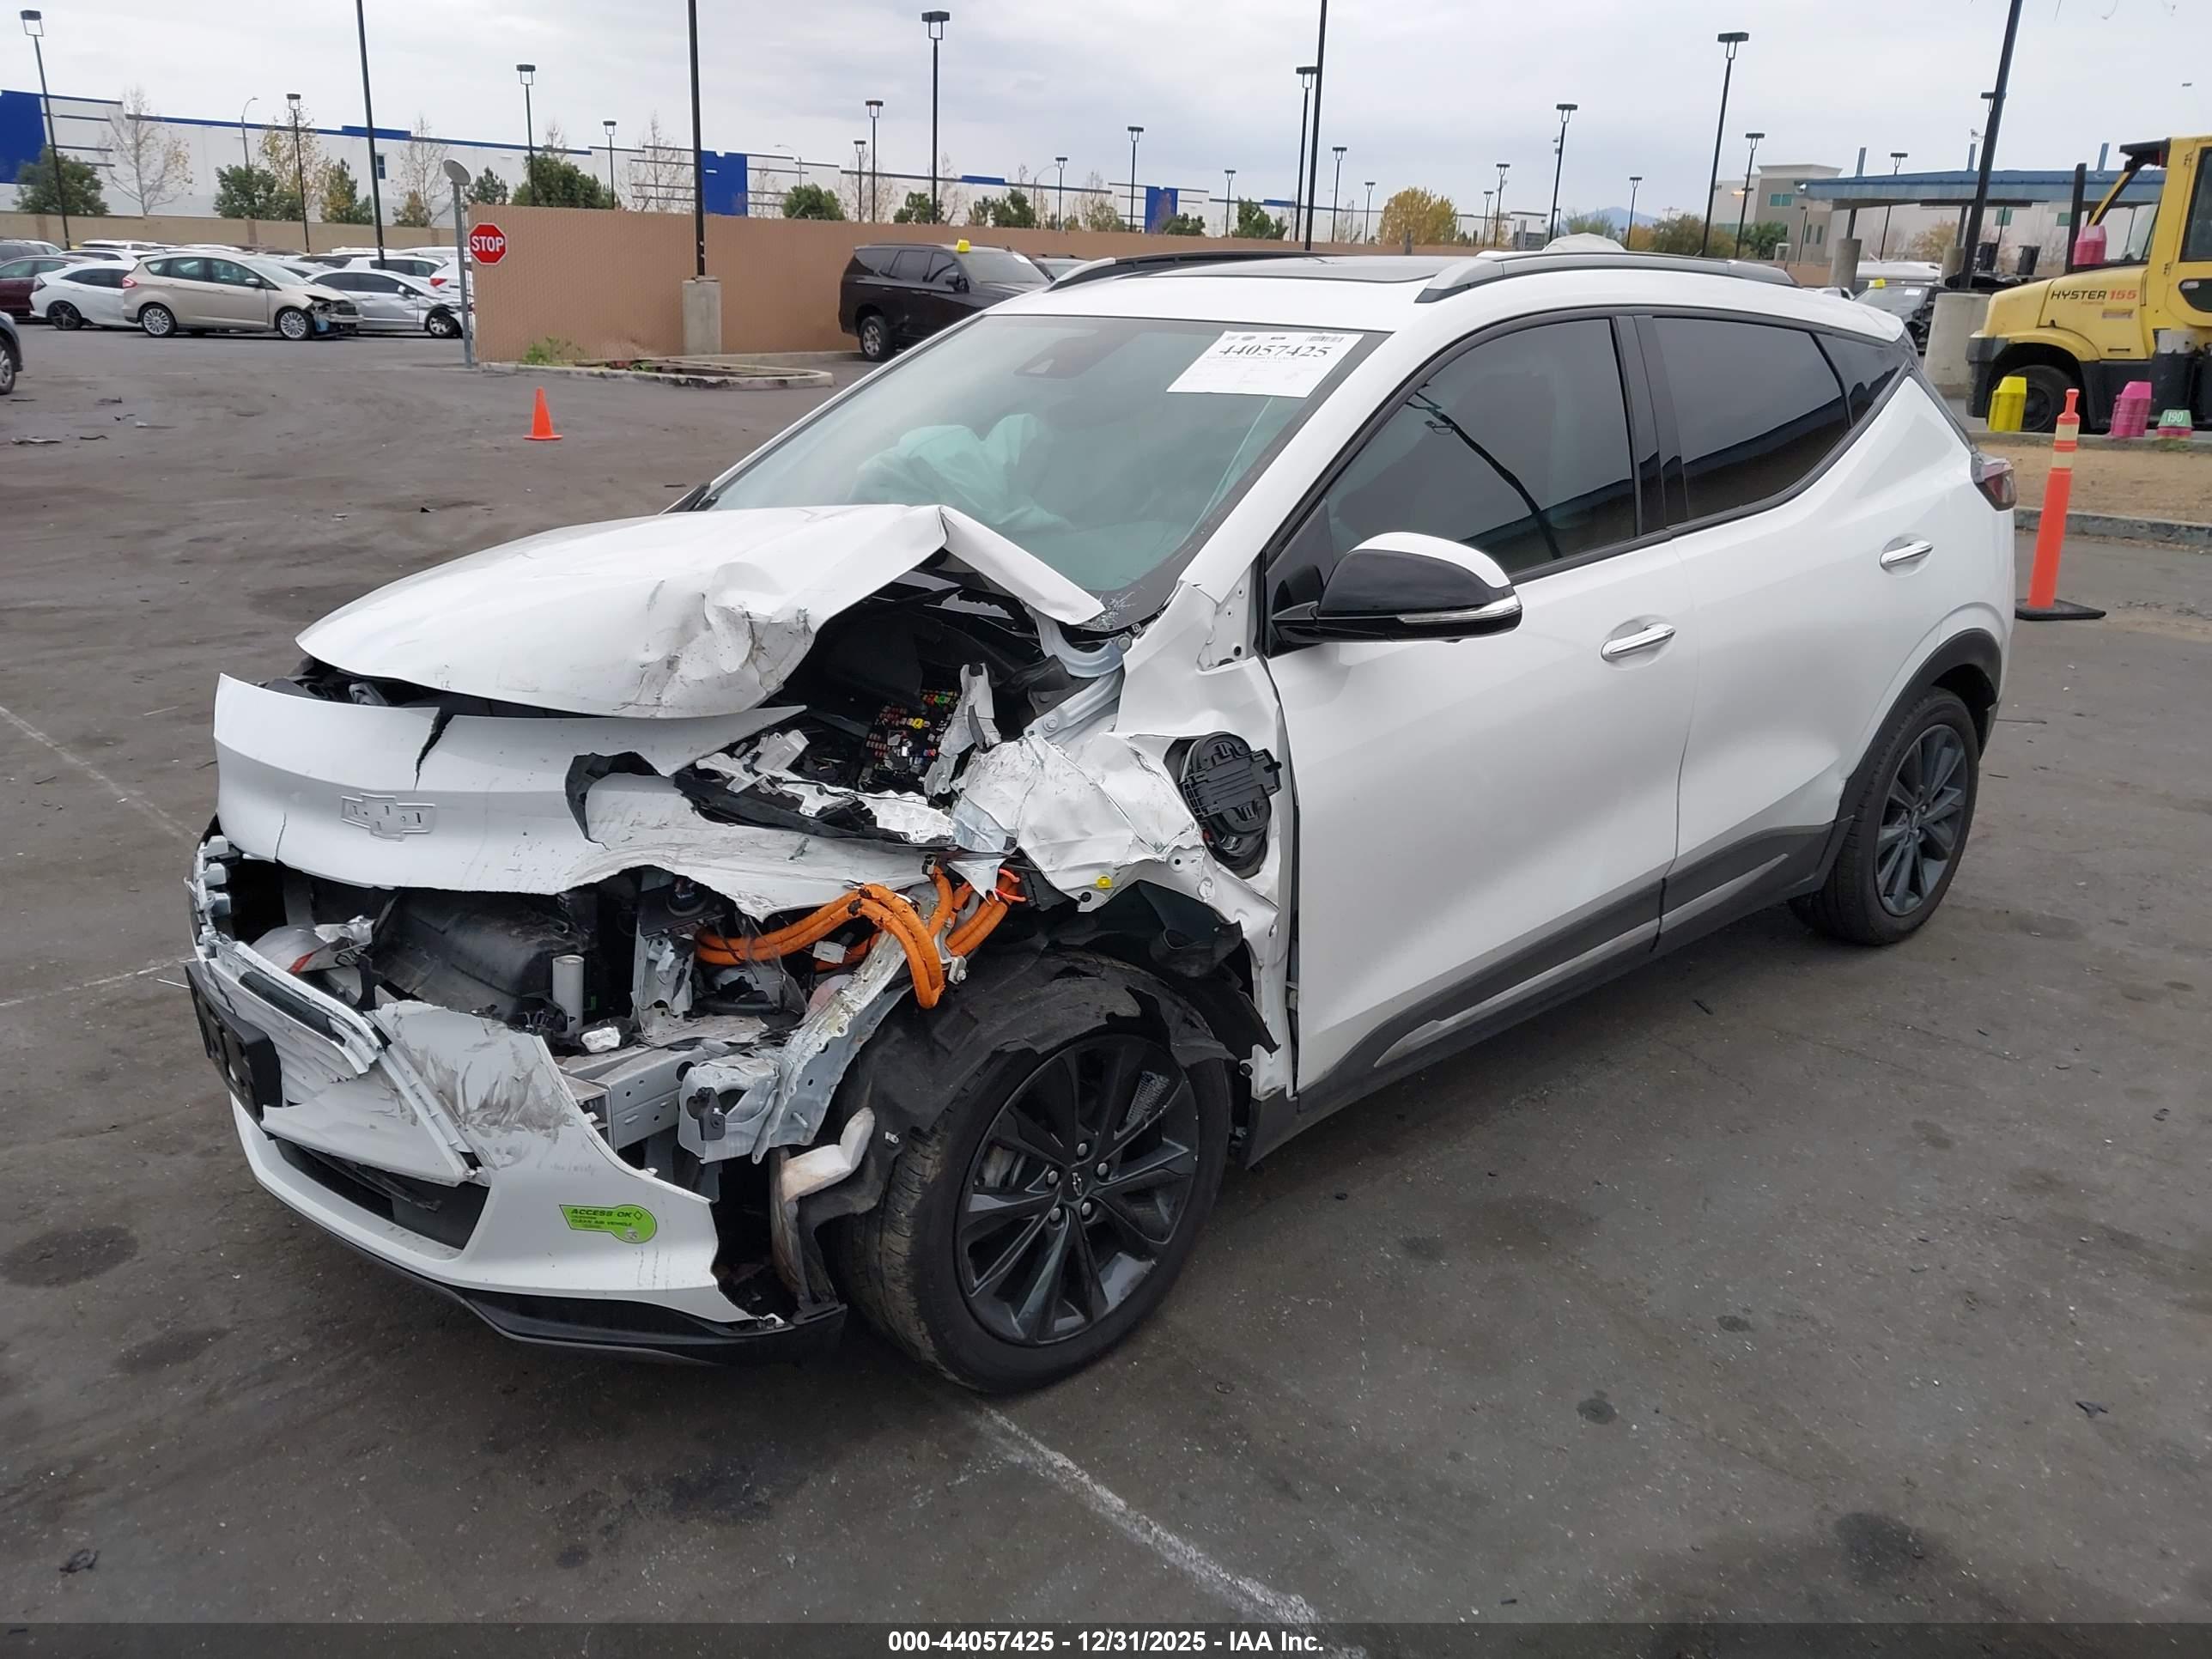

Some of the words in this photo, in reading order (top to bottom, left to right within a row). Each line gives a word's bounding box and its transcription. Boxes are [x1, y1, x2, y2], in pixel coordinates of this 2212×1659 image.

[471, 235, 504, 252] STOP
[2051, 290, 2107, 300] HYSTER
[2110, 289, 2137, 300] 155
[1218, 344, 1333, 357] 44057425
[2167, 411, 2184, 422] 190
